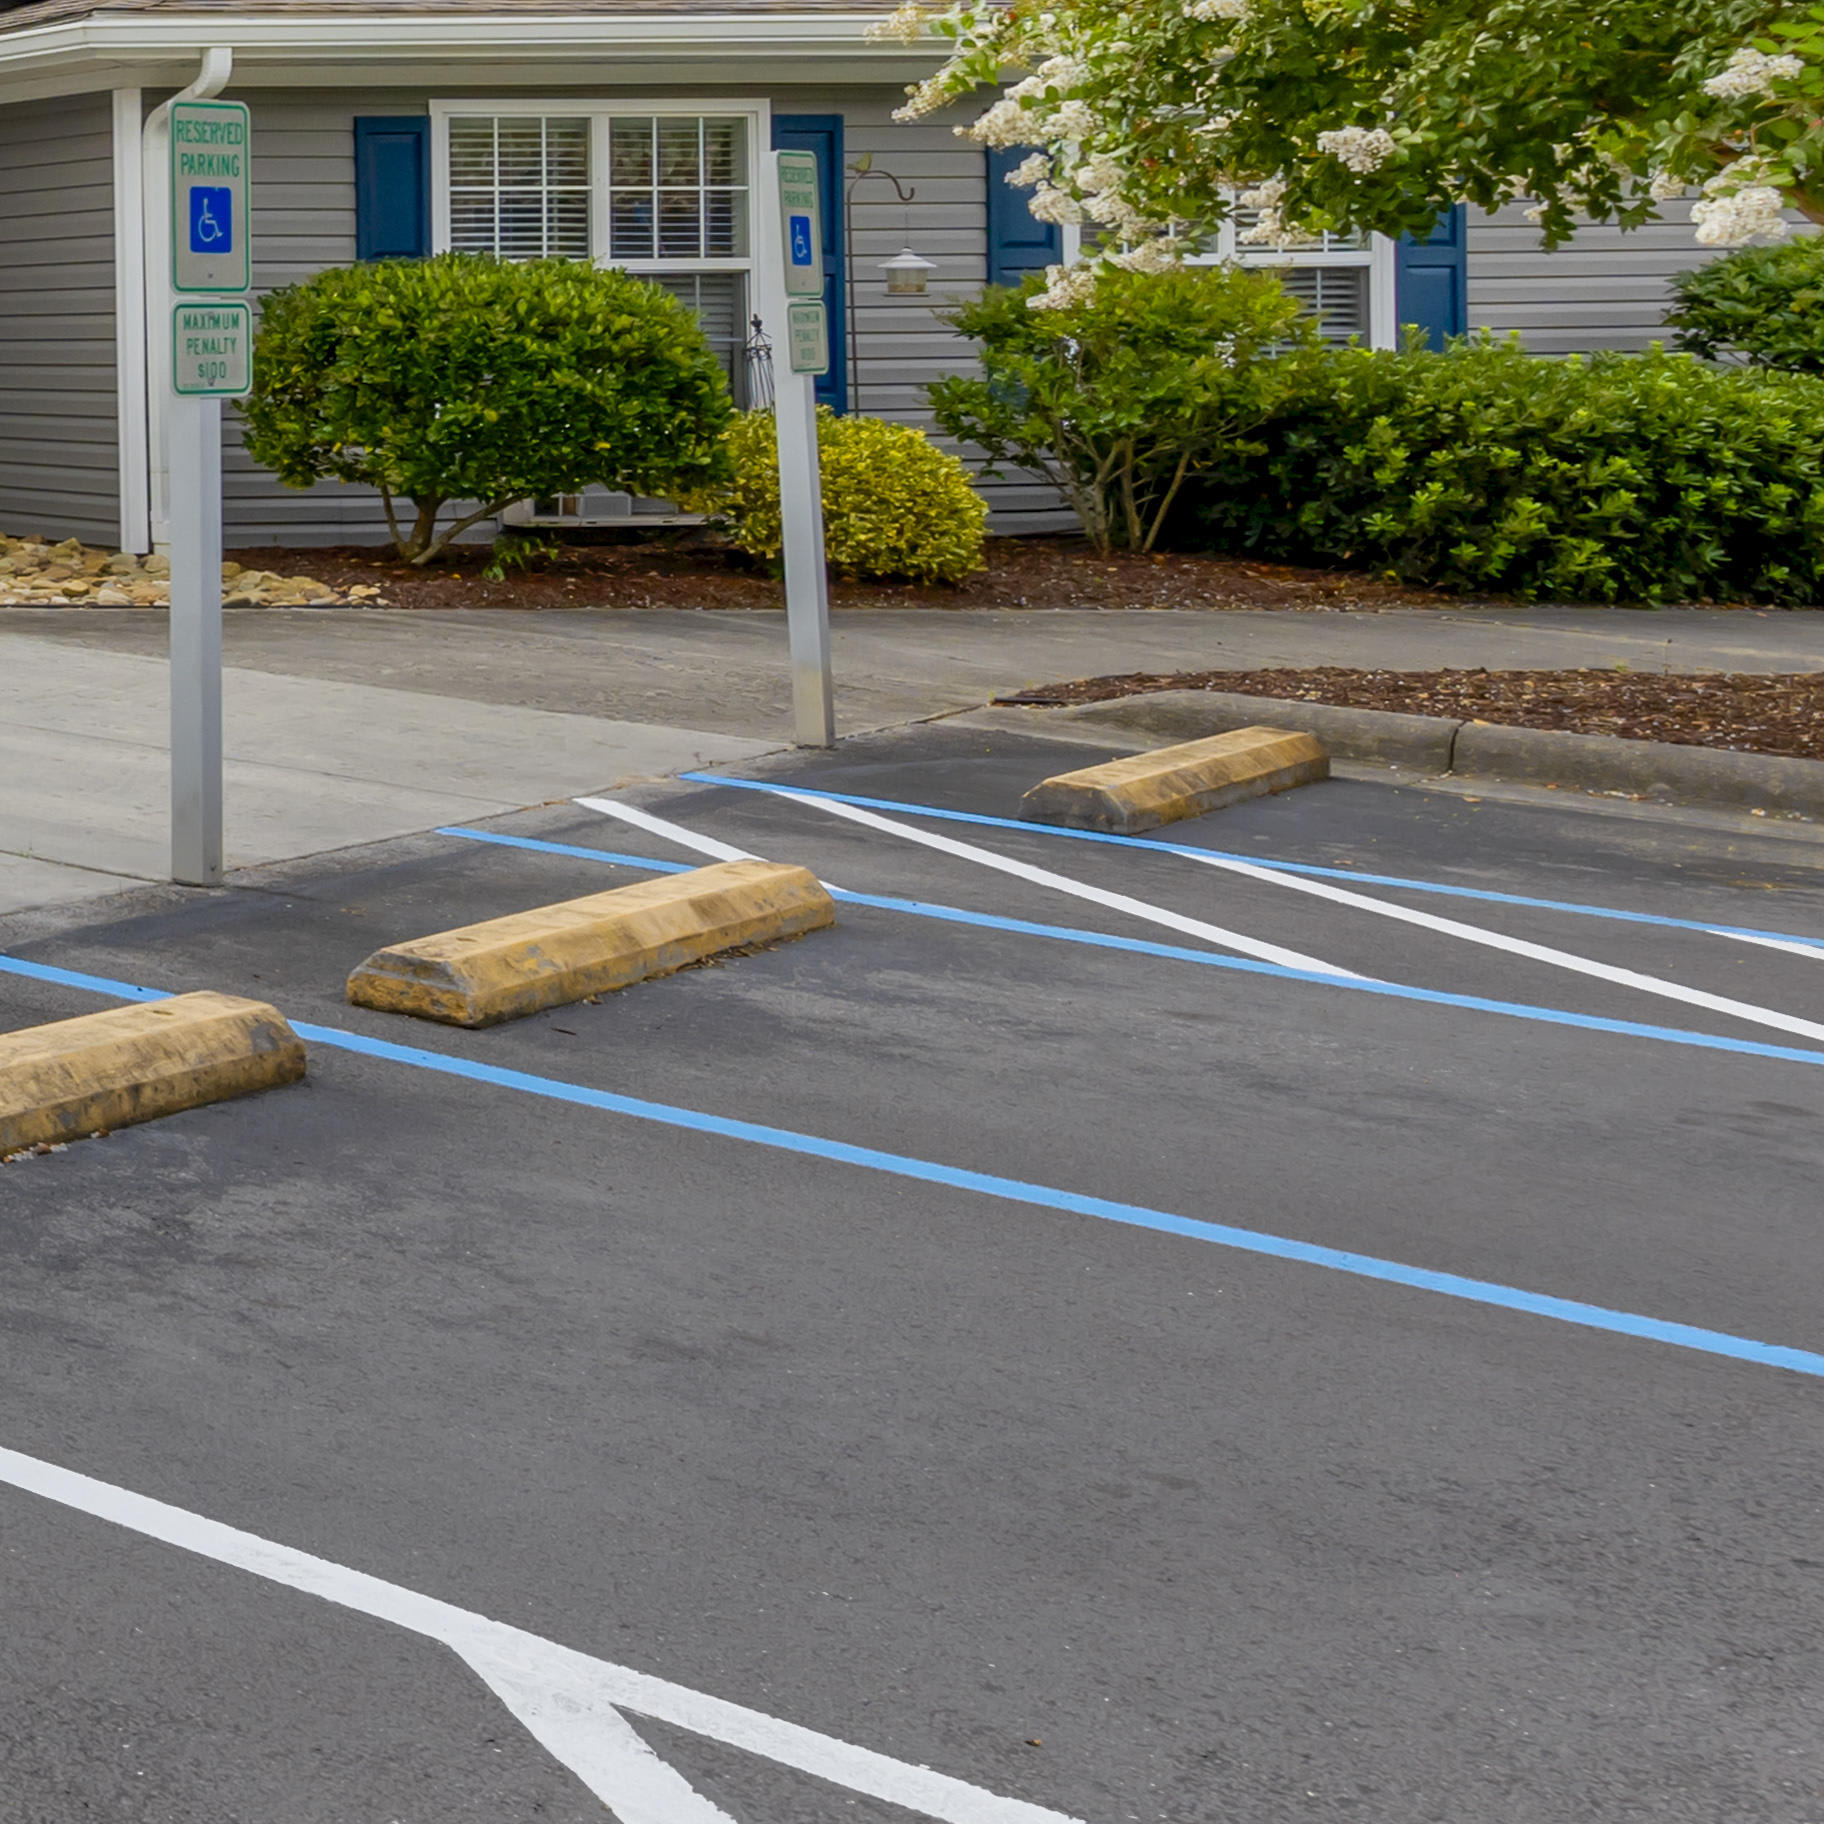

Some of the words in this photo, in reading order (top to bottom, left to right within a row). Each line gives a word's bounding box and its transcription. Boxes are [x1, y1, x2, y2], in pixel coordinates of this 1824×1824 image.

[176, 120, 243, 145] RESERVED
[181, 153, 240, 177] PARKING
[183, 313, 240, 330] MAXIMUM
[186, 337, 237, 355] PENALTY
